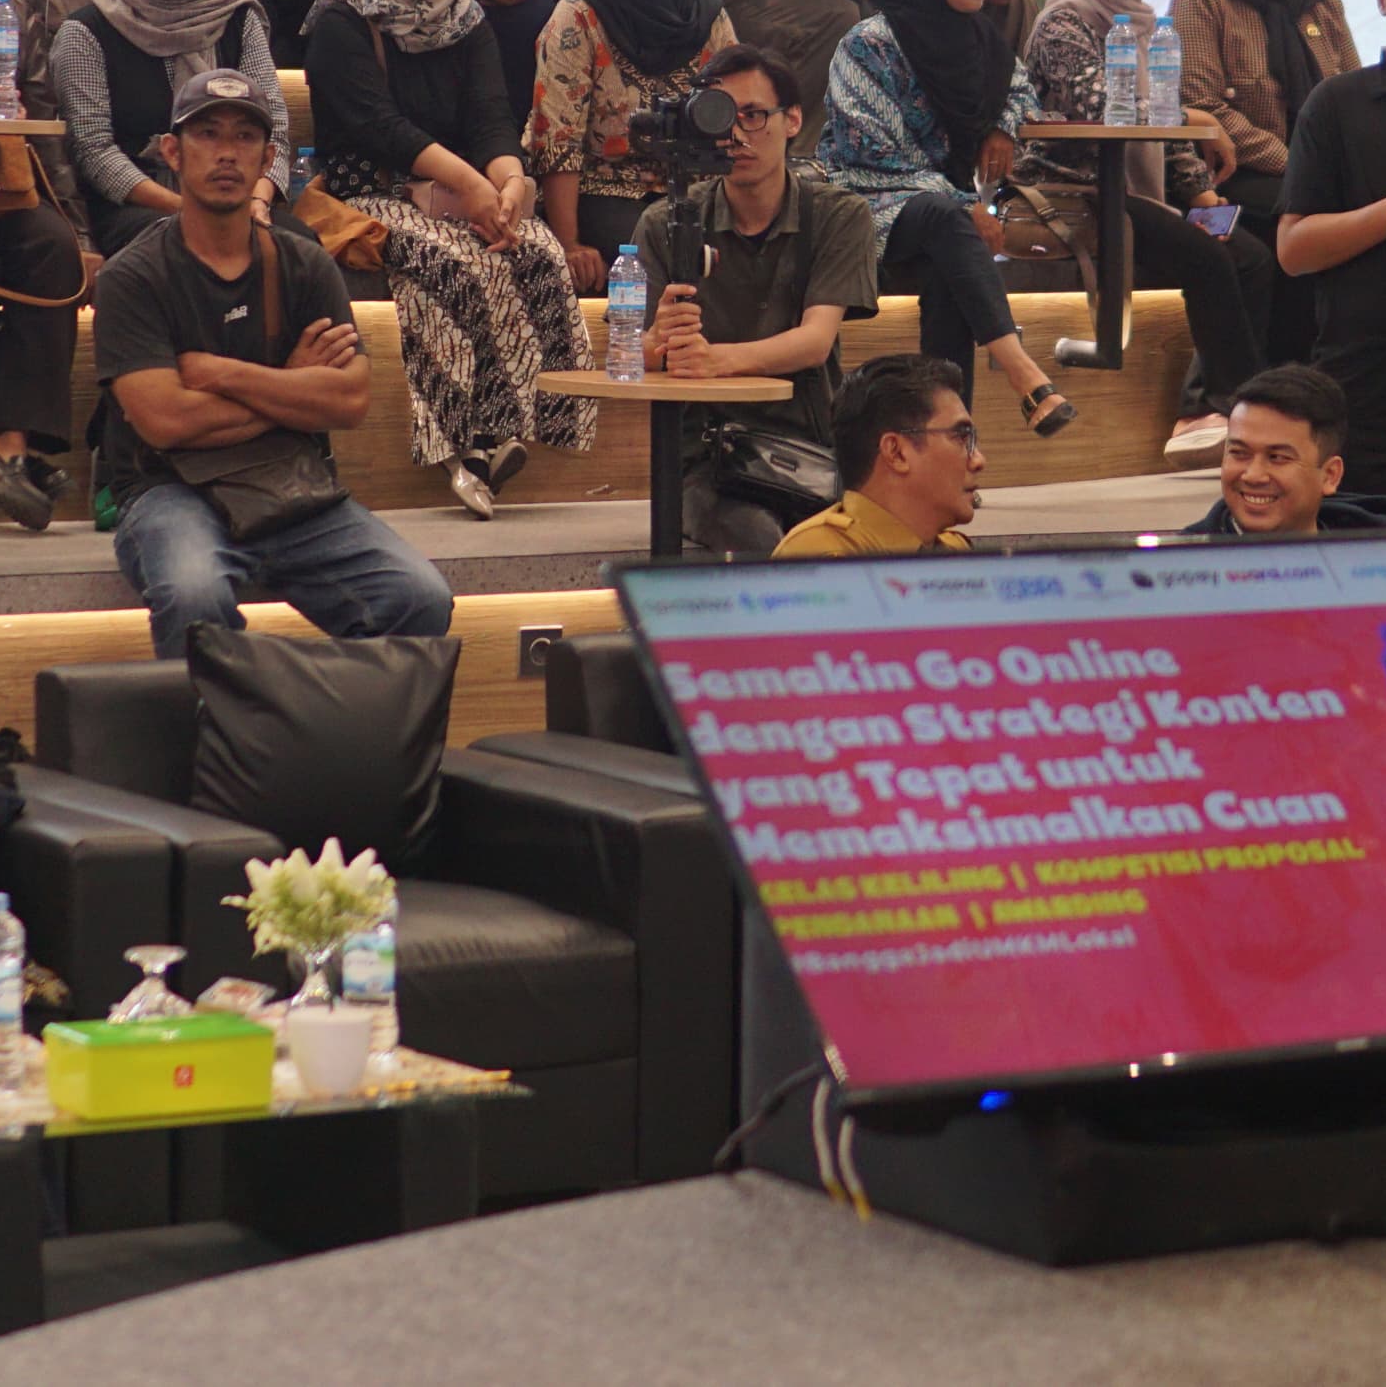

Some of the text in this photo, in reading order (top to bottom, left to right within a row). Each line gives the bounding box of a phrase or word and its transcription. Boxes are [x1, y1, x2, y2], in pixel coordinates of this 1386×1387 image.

[663, 638, 1181, 702] Semakin Go Online
[688, 684, 1347, 762] dengan Strategi Konten
[714, 736, 1205, 821] yang Tepat untuk
[731, 790, 1348, 864] Memaksimalkan Cuan
[859, 864, 1006, 899] KELILING
[1034, 850, 1203, 886] KOMPETISI
[1202, 837, 1366, 870] PROPOSAL
